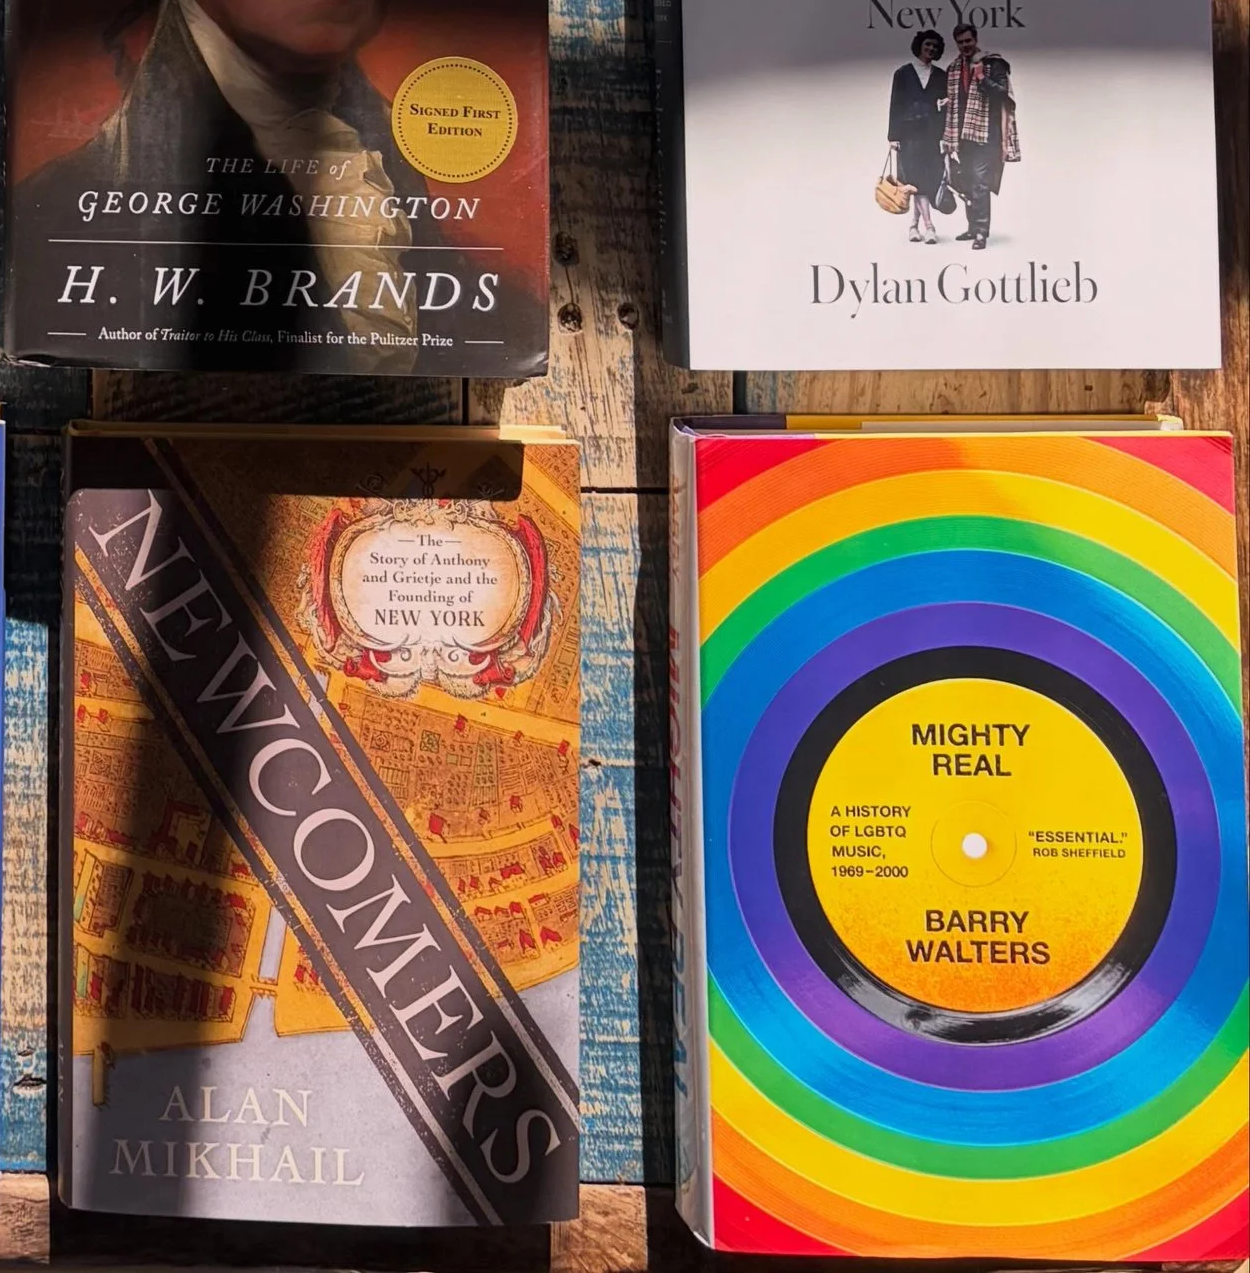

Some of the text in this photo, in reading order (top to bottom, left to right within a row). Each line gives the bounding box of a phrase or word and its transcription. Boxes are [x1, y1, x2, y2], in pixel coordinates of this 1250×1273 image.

[78, 190, 481, 221] GEORGE WASHINGTON
[57, 266, 499, 312] H. W. BRANDS
[811, 261, 1098, 319] Dylan Gottlieb
[369, 552, 490, 570] Story of Anthony
[362, 571, 498, 587] and Grietje and the
[388, 590, 474, 606] Founding of
[375, 609, 486, 626] NEW YORK
[912, 723, 1030, 747] MIGHTY
[932, 753, 1012, 777] REAL
[830, 806, 911, 818] A HISTORY
[89, 489, 559, 1183] NEWCOMERS
[830, 826, 907, 839] OF LGBTQ
[832, 846, 886, 860] MUSIC,
[1032, 847, 1126, 859] ROB SHEFFIELD
[925, 910, 1029, 933] BARRY
[906, 940, 1050, 965] WALTERS
[159, 1085, 312, 1127] ALAN
[110, 1139, 366, 1187] MIKHAIL
